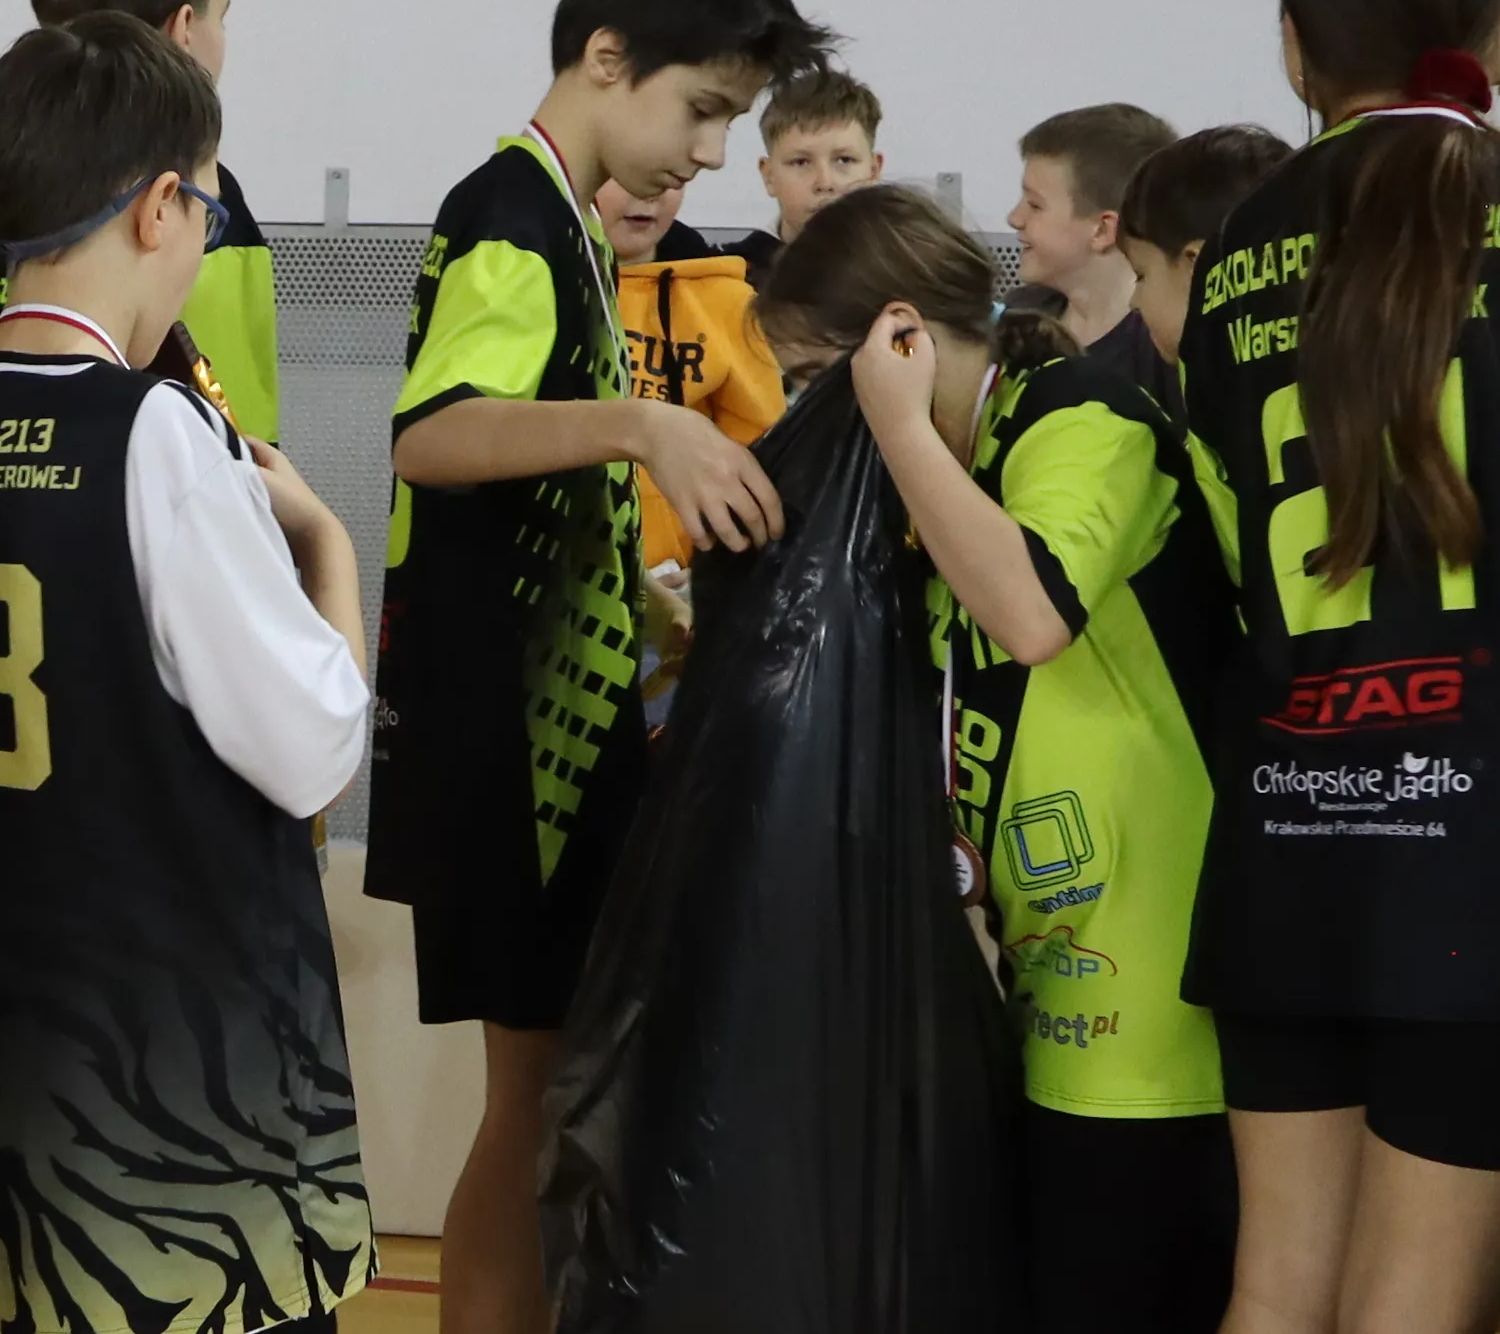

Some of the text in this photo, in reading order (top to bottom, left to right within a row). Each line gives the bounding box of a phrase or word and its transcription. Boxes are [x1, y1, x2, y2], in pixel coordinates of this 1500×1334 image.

[1202, 242, 1279, 316] SZKOŁA
[1228, 314, 1299, 364] Warsz
[1285, 669, 1464, 724] STAG
[1253, 755, 1473, 804] Chłopskie jadło
[1426, 823, 1446, 837] 64
